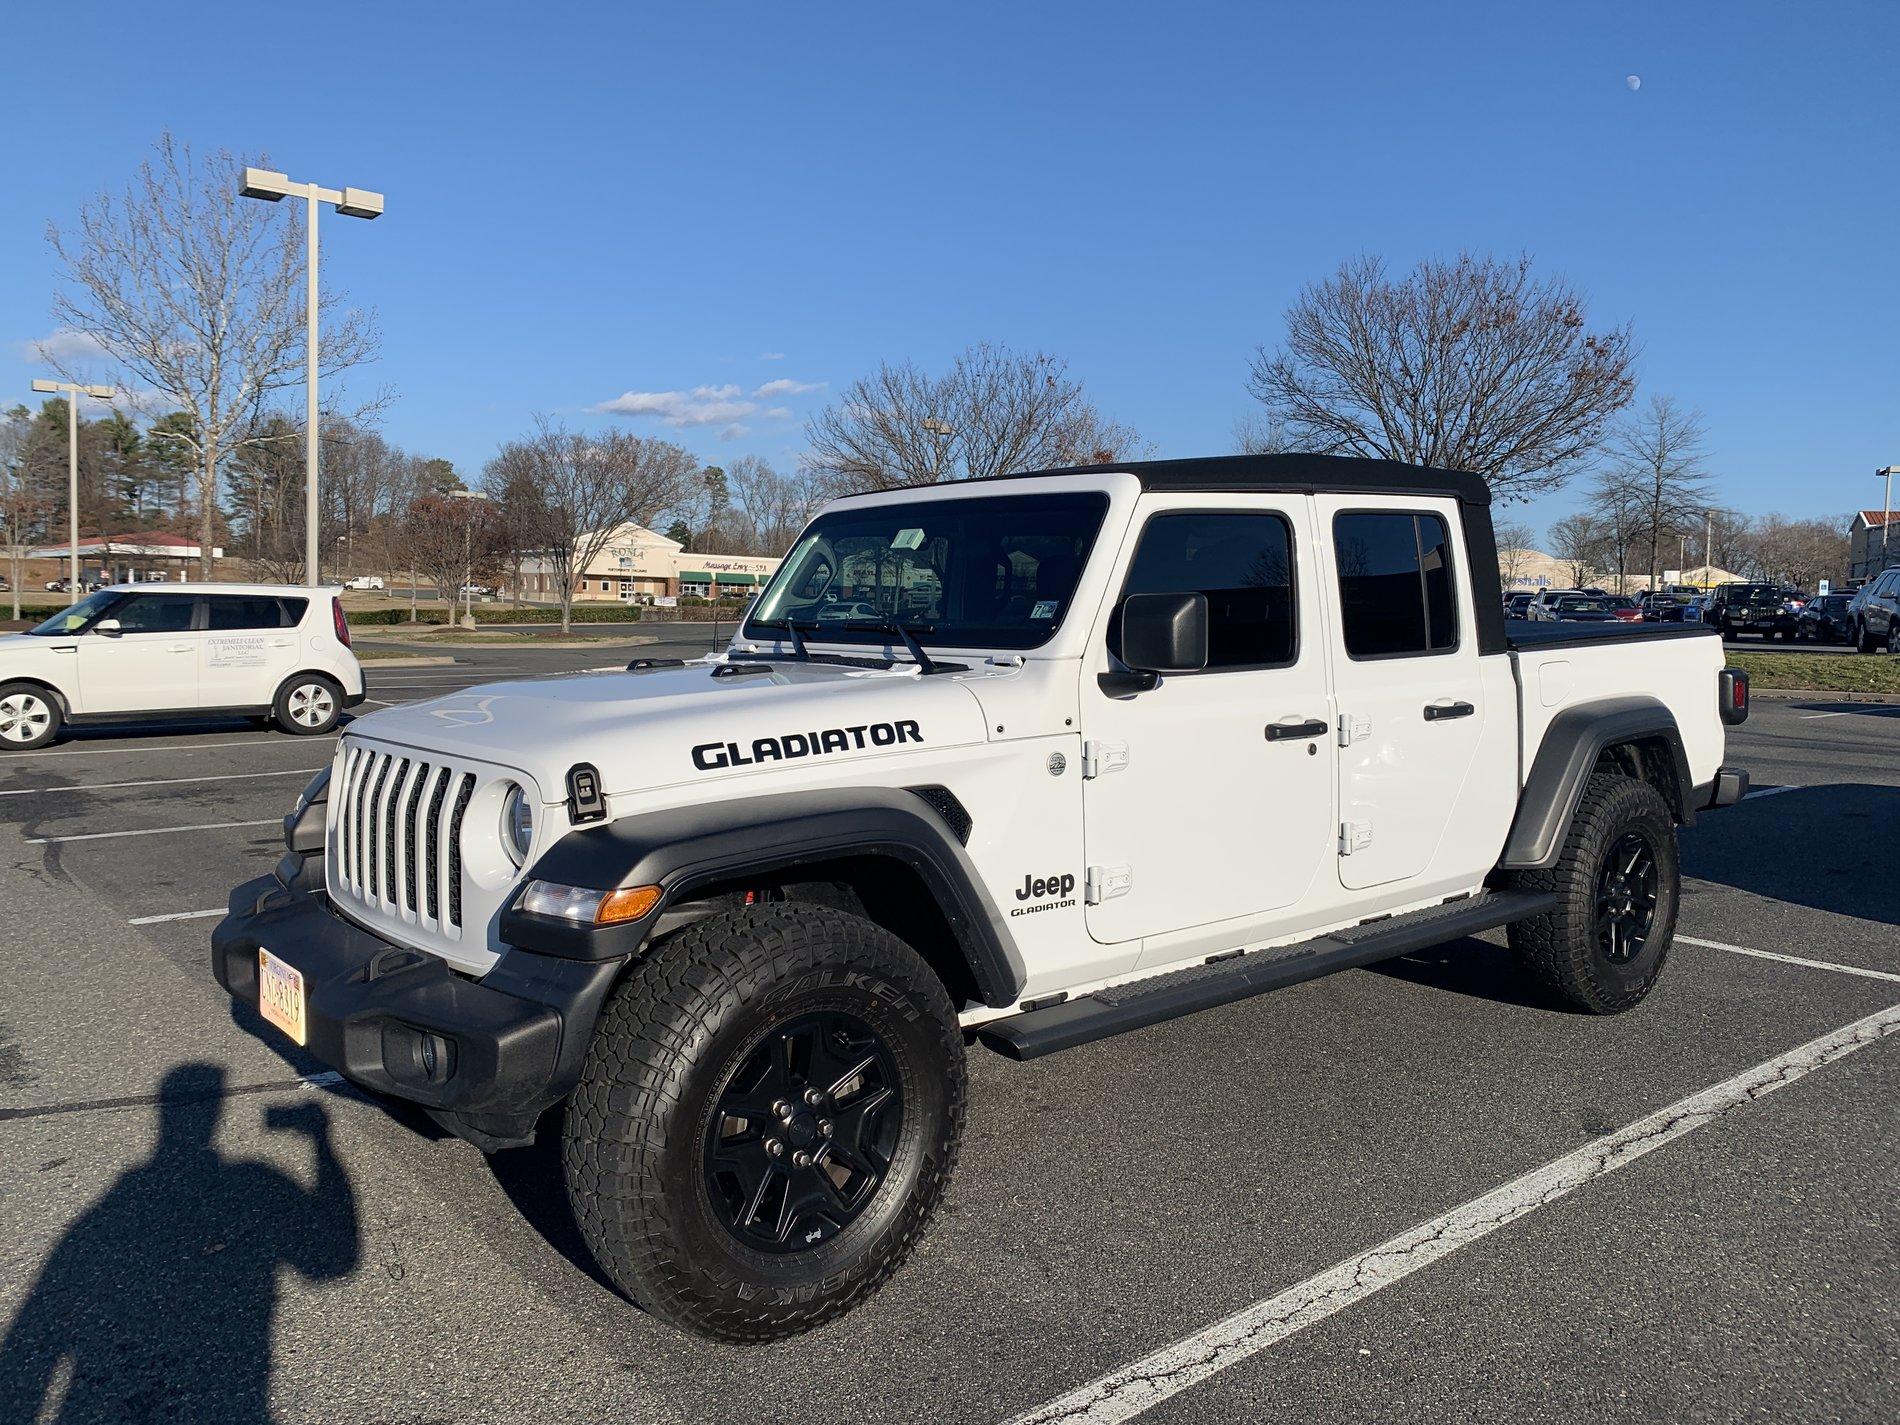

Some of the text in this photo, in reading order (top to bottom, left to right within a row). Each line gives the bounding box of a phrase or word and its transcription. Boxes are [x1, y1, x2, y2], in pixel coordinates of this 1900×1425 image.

[611, 548, 644, 560] ROMA
[702, 561, 731, 571] Massage
[1034, 605, 1043, 616] 7
[691, 719, 924, 771] GLADIATOR
[1015, 873, 1075, 901] Jeep
[1011, 899, 1076, 917] GLADIATOR
